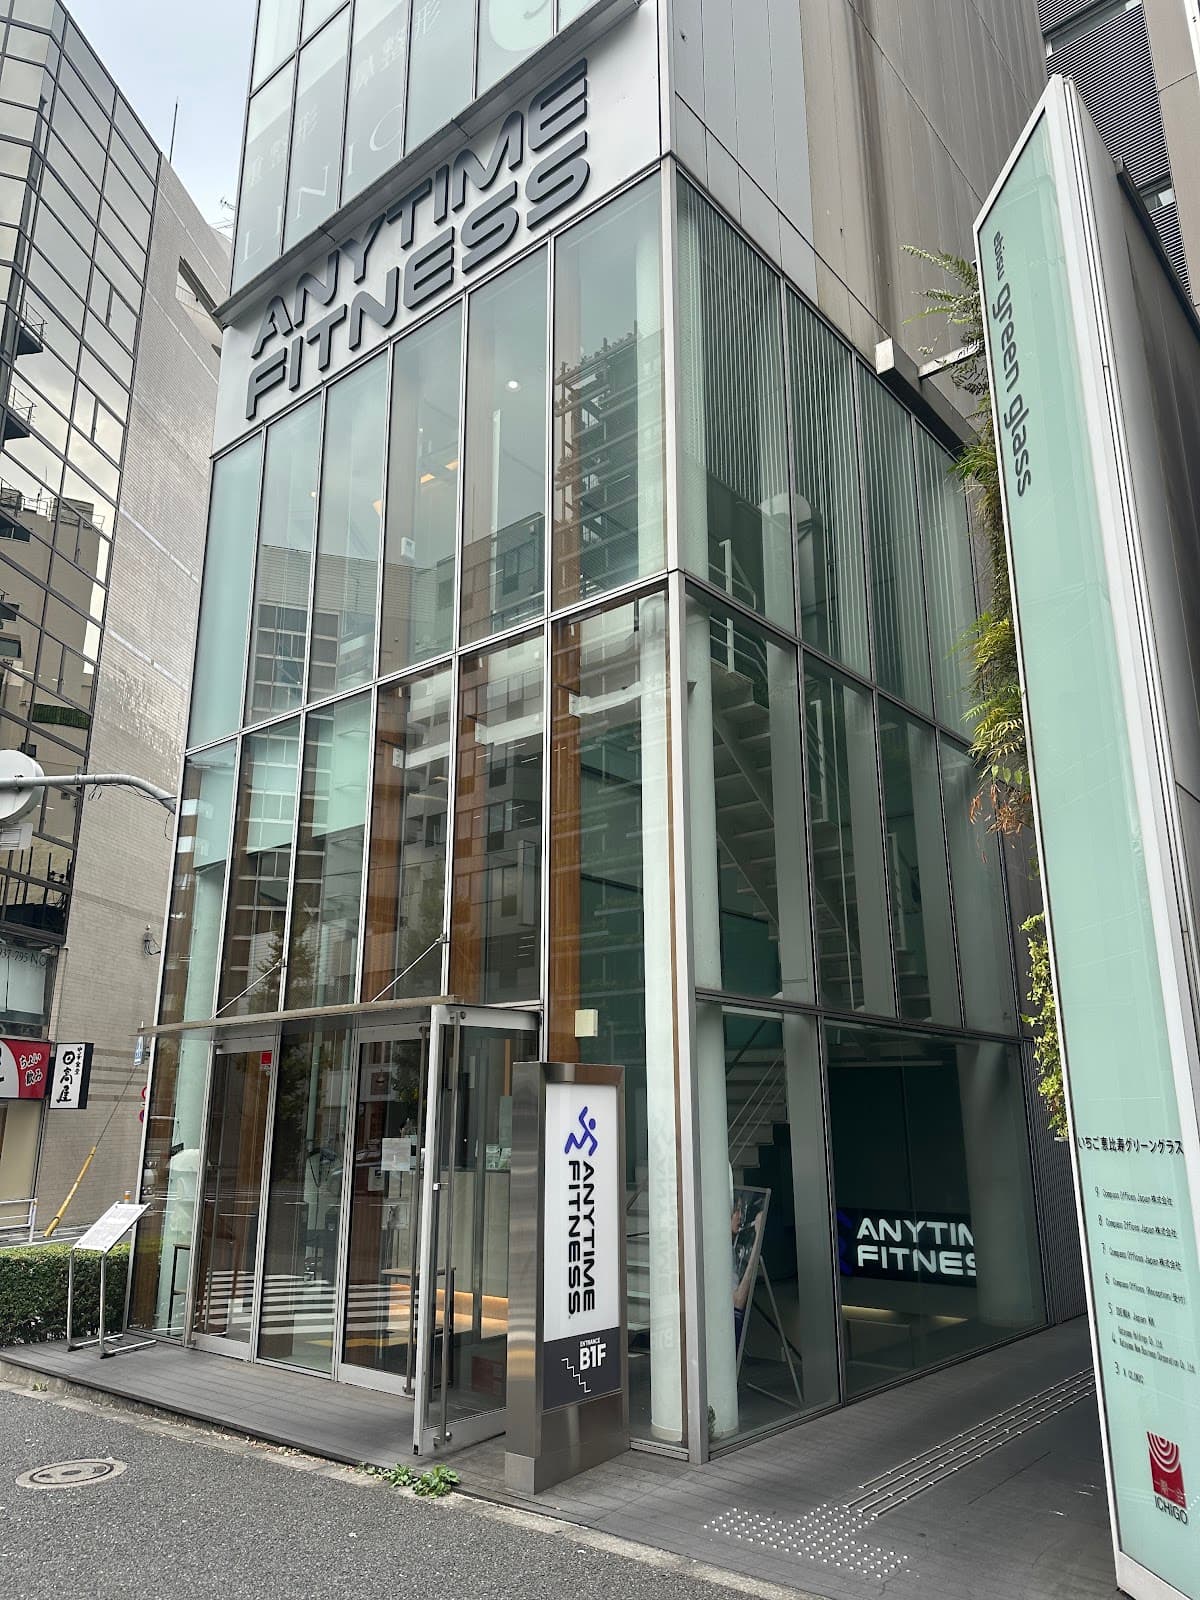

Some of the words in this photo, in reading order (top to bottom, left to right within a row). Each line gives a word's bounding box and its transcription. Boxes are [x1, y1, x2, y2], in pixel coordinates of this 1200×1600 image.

[251, 57, 588, 359] ANYTIME
[993, 230, 1005, 281] ebisu
[246, 130, 590, 421] FITNESS
[992, 282, 1020, 393] green
[1004, 393, 1032, 497] glass
[19, 1053, 42, 1070] ちょい
[25, 1068, 43, 1086] 飲み
[56, 1051, 76, 1103] 日高屋
[1078, 1136, 1185, 1155] いちご恵比寿グリーングラス
[1094, 1186, 1099, 1197] 9
[1138, 1193, 1151, 1203] Japan
[568, 1160, 581, 1316] FITNESS
[583, 1160, 595, 1312] ANYTIME
[857, 1217, 974, 1247] ANYTI
[1098, 1214, 1102, 1226] 8
[1141, 1224, 1154, 1235] Japan
[857, 1244, 977, 1276] FITNE
[1100, 1242, 1106, 1255] 7
[1105, 1273, 1110, 1285] 6
[1108, 1302, 1113, 1315] 5
[580, 1343, 606, 1370] B1F
[1114, 1361, 1120, 1375] 3
[1155, 1495, 1188, 1525] ICHIGO
